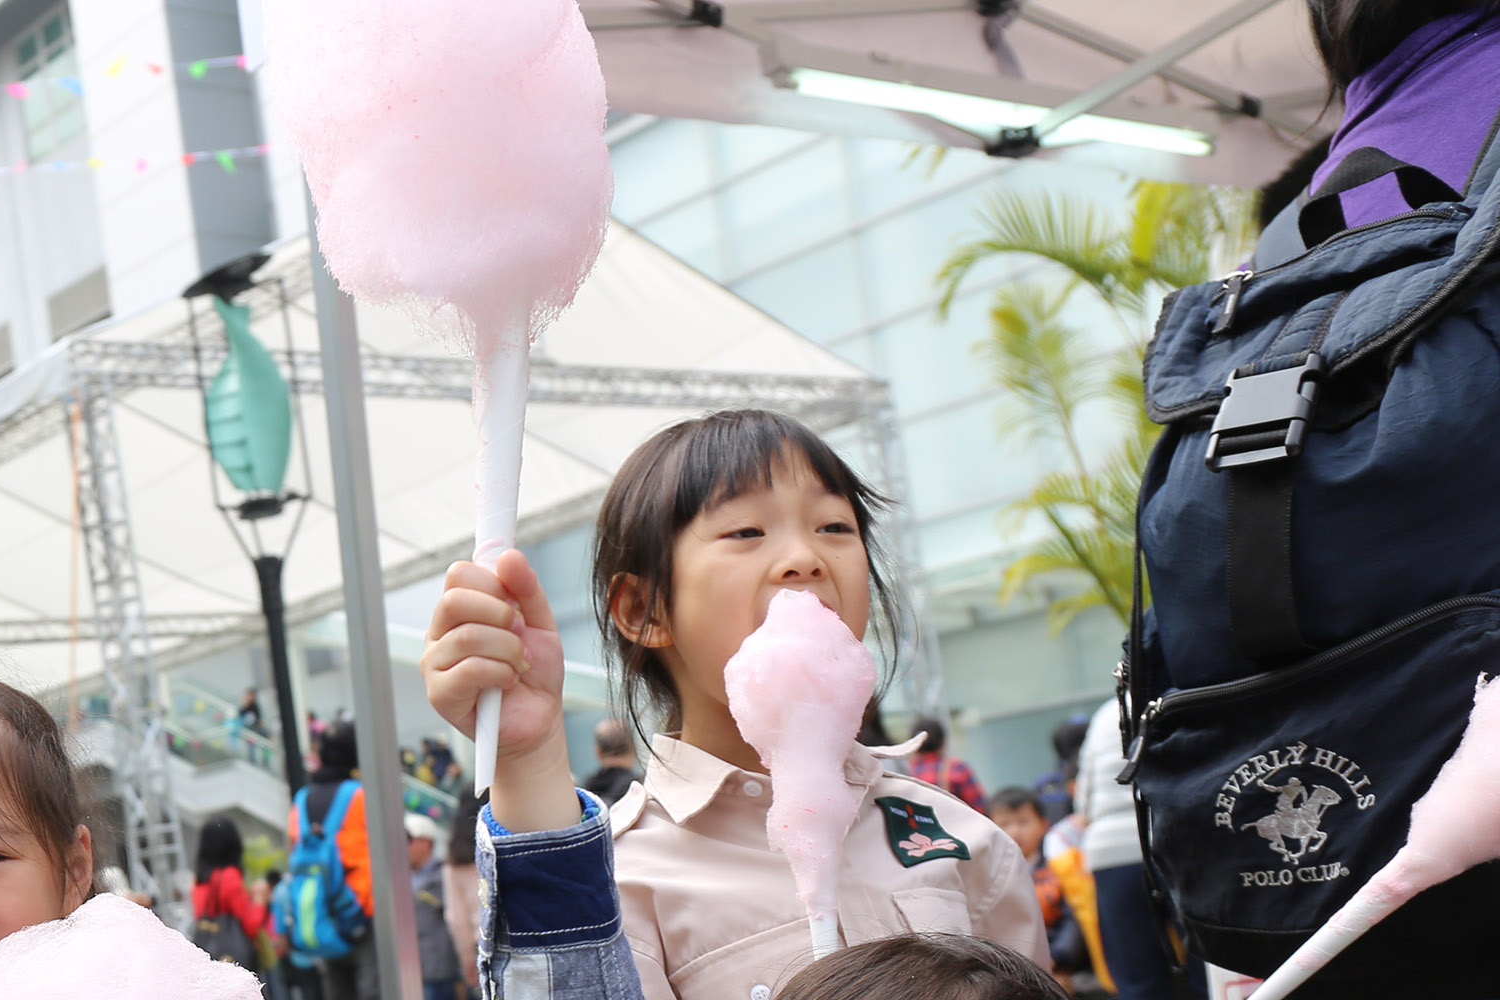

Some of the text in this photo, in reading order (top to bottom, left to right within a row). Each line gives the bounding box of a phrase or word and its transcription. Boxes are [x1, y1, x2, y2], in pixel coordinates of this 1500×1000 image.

[1215, 744, 1376, 830] BEVERLY HILLS
[1240, 869, 1293, 887] POLO
